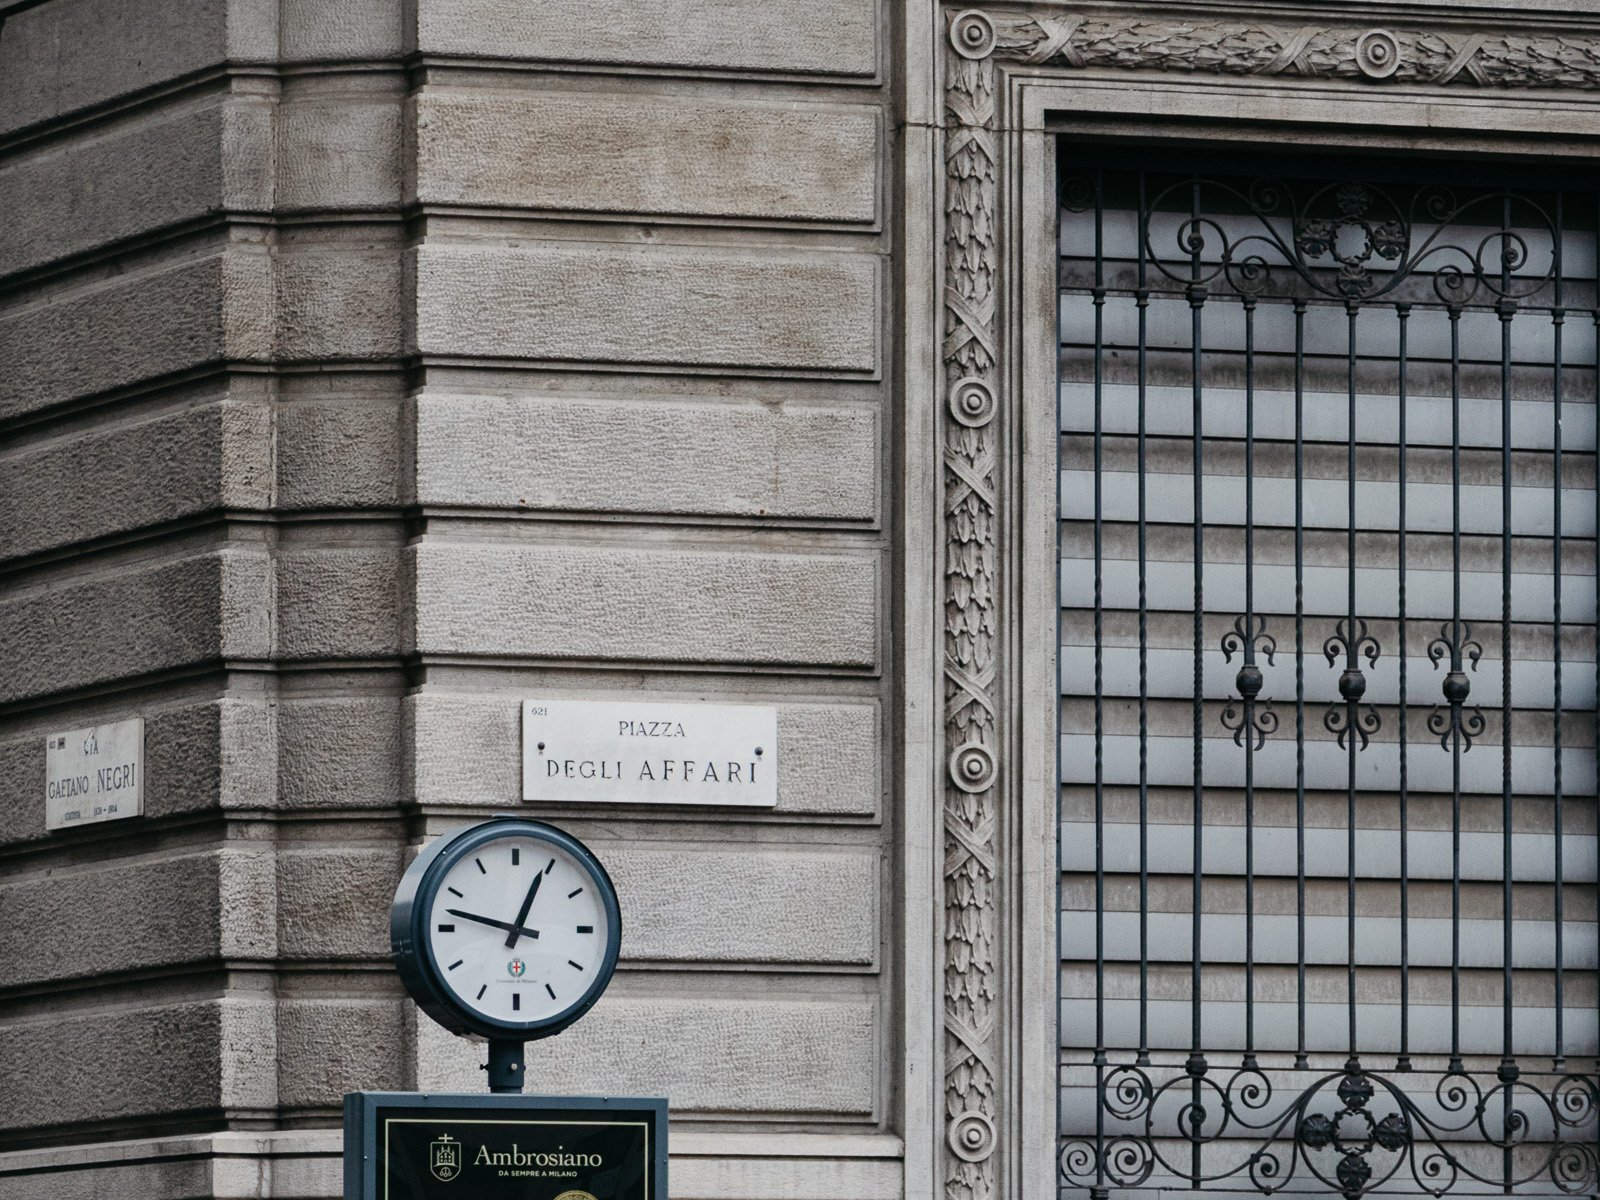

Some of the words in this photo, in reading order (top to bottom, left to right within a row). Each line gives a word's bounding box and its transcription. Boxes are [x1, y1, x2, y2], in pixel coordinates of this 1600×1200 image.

[531, 707, 548, 716] 621
[619, 720, 687, 738] PIAZZA
[48, 775, 90, 800] GAETANO
[97, 763, 135, 793] NEGRI
[546, 759, 623, 780] DEGLI
[638, 760, 757, 784] AFFARI
[473, 1144, 603, 1167] Ambrosiano
[511, 1170, 540, 1178] SEMPRE
